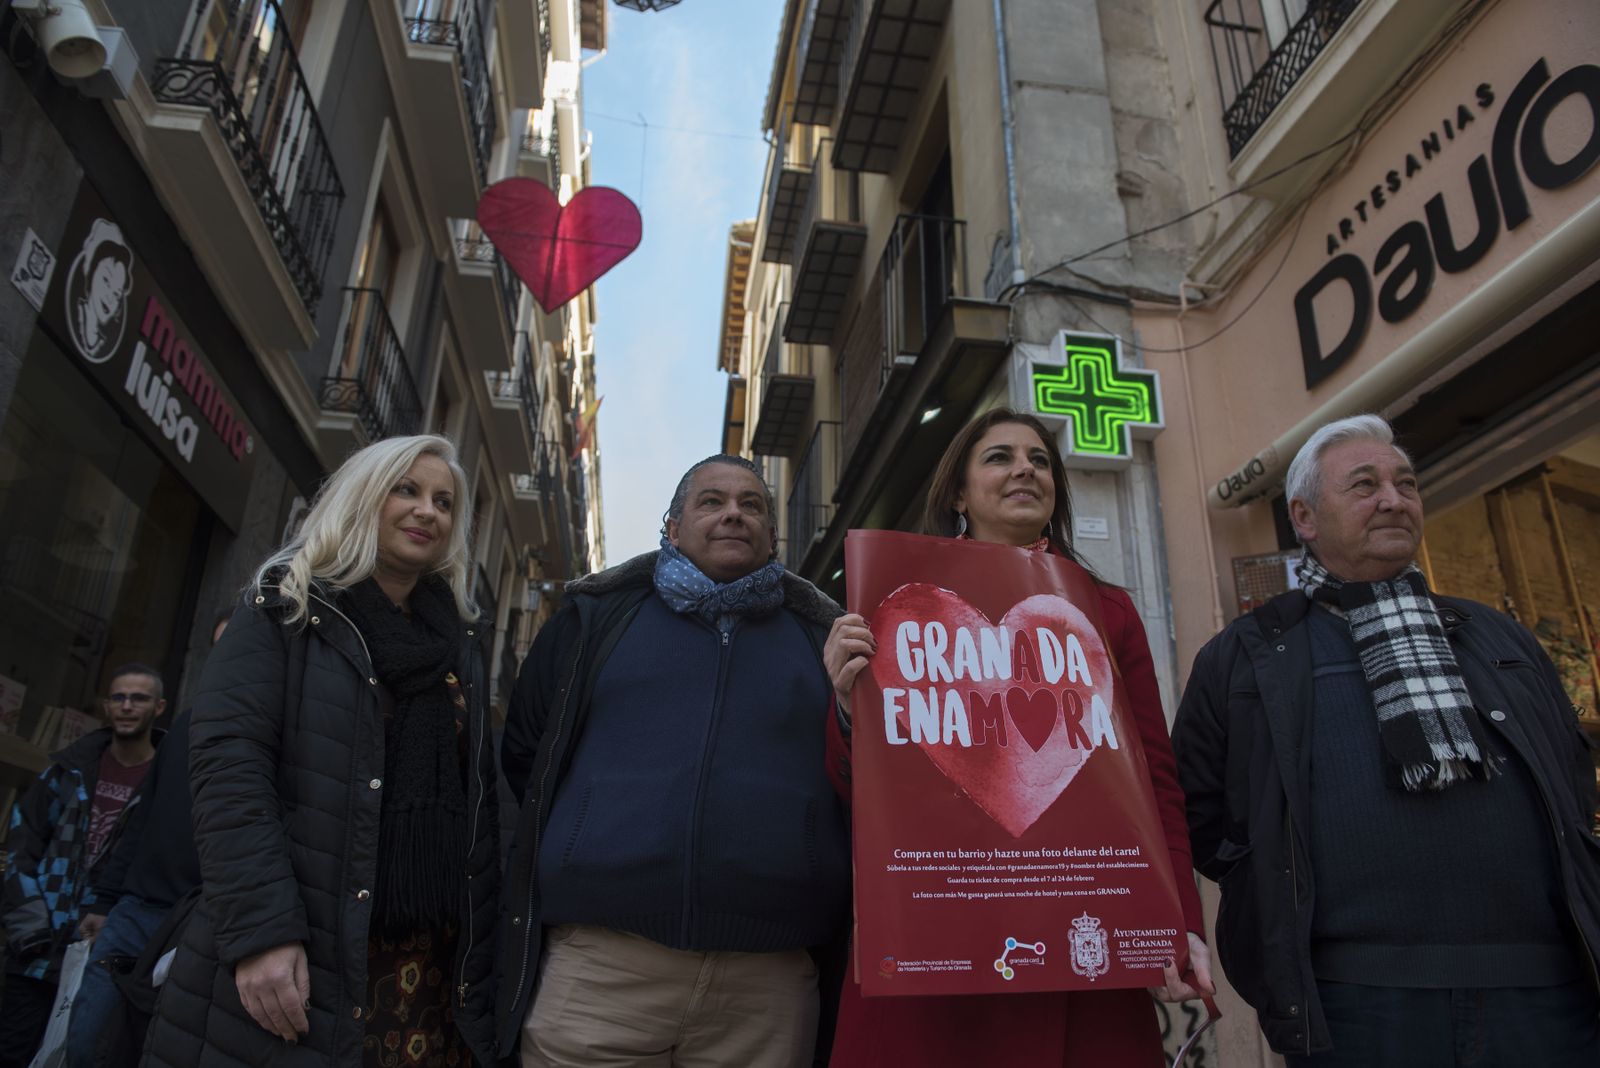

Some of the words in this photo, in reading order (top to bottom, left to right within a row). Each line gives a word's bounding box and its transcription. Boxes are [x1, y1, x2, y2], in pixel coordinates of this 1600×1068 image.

[1325, 83, 1495, 256] ARTESANIAS
[1293, 57, 1600, 391] Dauro
[139, 295, 248, 461] mamma
[124, 340, 199, 463] luisa
[1217, 458, 1265, 501] Dauro
[896, 621, 1093, 686] GRANADA
[886, 864, 907, 872] Súbela
[922, 864, 938, 872] redes
[938, 864, 961, 872] sociales
[966, 864, 996, 873] etiquétala
[1065, 864, 1070, 872] y
[1070, 861, 1096, 870] #nombre
[1096, 861, 1106, 870] del
[1105, 861, 1149, 869] establecimiento
[893, 849, 932, 862] Compra
[933, 851, 945, 859] en
[946, 850, 957, 859] tu
[958, 848, 986, 859] barrio
[987, 852, 993, 862] y
[995, 848, 1021, 859] hazte
[1022, 850, 1040, 858] una
[1041, 847, 1061, 858] foto
[1062, 846, 1098, 857] delante
[1099, 846, 1113, 857] del
[1114, 845, 1140, 857] cartel
[912, 891, 920, 899] La
[920, 891, 934, 899] foto
[944, 891, 957, 899] más
[957, 891, 968, 899] Me
[967, 892, 984, 901] gusta
[984, 891, 1004, 900] ganará
[1015, 890, 1034, 898] noche
[1033, 889, 1042, 897] de
[1041, 889, 1058, 898] hotel
[1057, 891, 1063, 899] y
[1073, 889, 1089, 897] cena
[1096, 887, 1131, 896] GRANADA
[946, 877, 968, 885] Guarda
[975, 876, 992, 884] ticket
[992, 876, 1000, 884] de
[1000, 877, 1022, 886] compra
[1022, 875, 1040, 883] desde
[1040, 875, 1047, 883] el
[1066, 874, 1073, 882] de
[1073, 874, 1095, 882] febrero
[1008, 957, 1029, 965] granada
